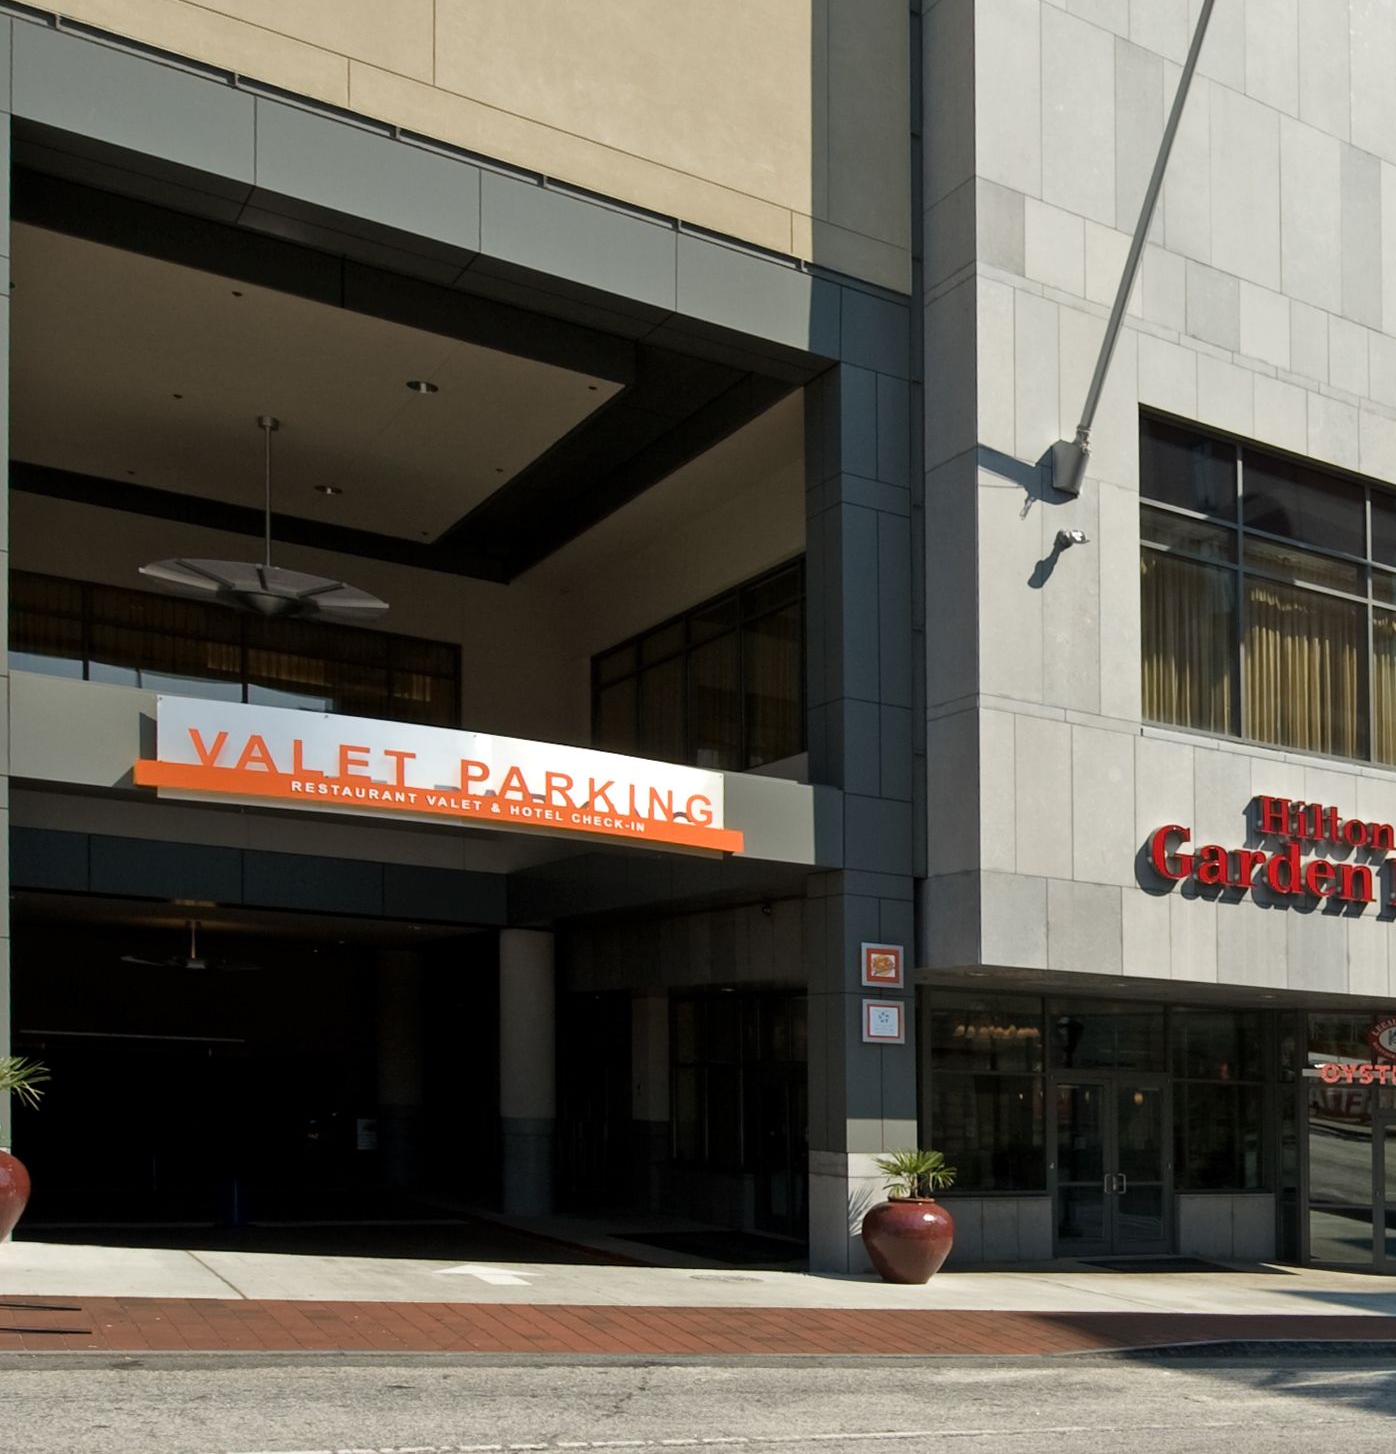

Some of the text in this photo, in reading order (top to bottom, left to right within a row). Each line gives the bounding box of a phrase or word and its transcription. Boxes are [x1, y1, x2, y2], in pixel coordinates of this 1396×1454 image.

[188, 727, 716, 827] VALET PARKING
[290, 780, 646, 833] RESTAURANT VALET & HOTEL CHECK-IN
[1150, 824, 1377, 904] Garden
